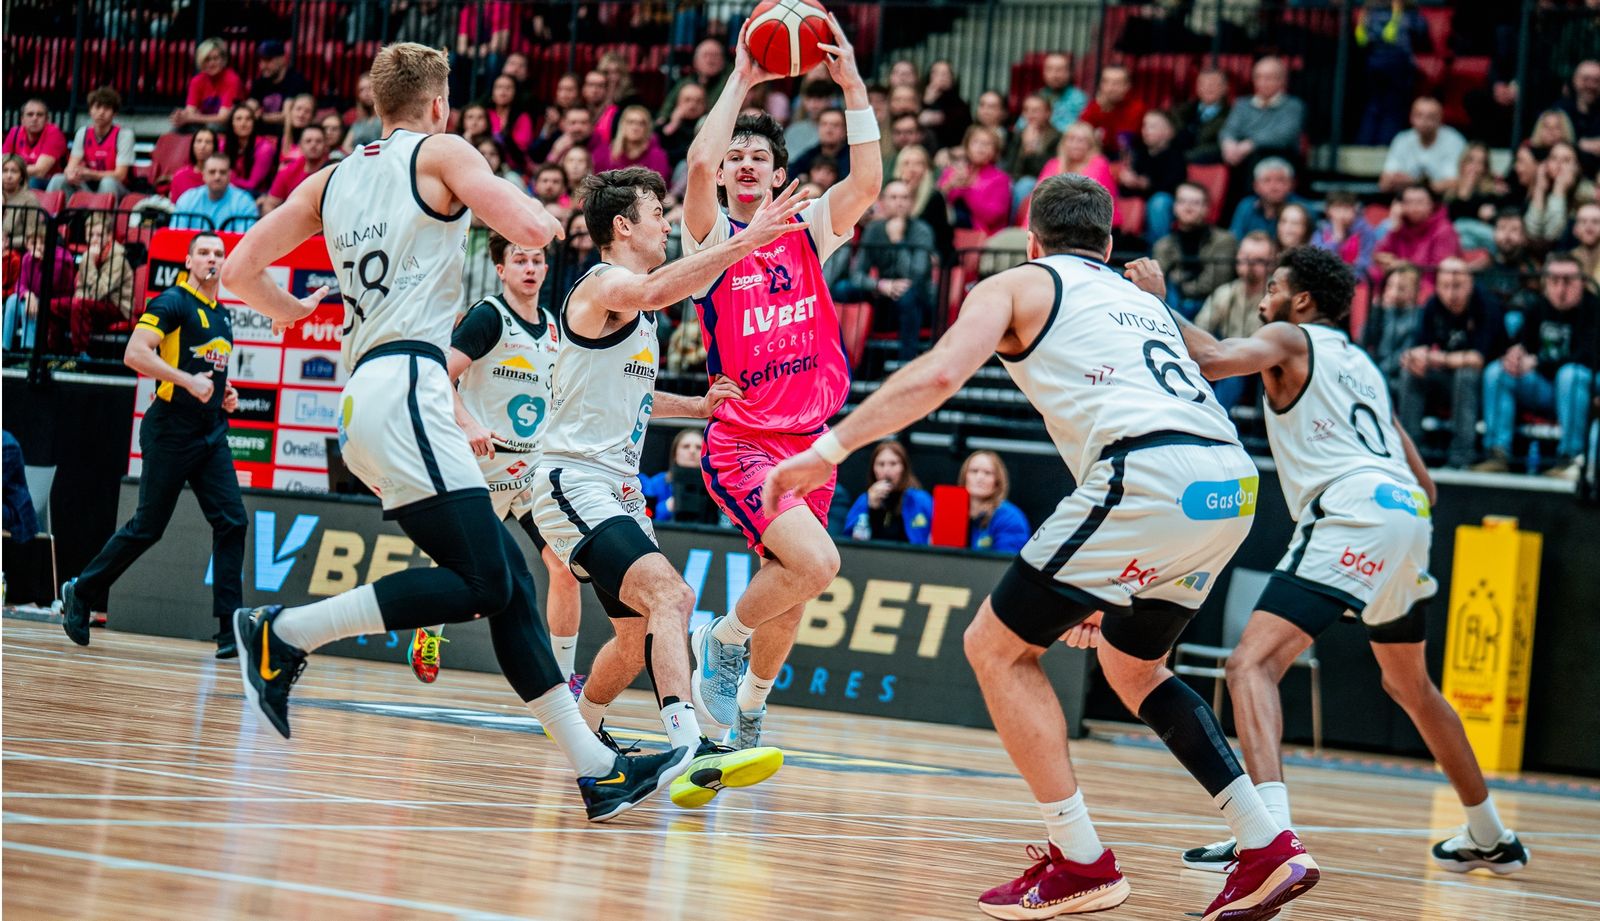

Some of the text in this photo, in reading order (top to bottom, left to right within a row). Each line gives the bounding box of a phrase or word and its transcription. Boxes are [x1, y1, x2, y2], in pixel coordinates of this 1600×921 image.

[766, 264, 792, 295] 23
[753, 330, 815, 357] SCORES
[492, 366, 539, 383] aimasa
[1142, 339, 1208, 404] 6
[775, 662, 898, 703] ORES
